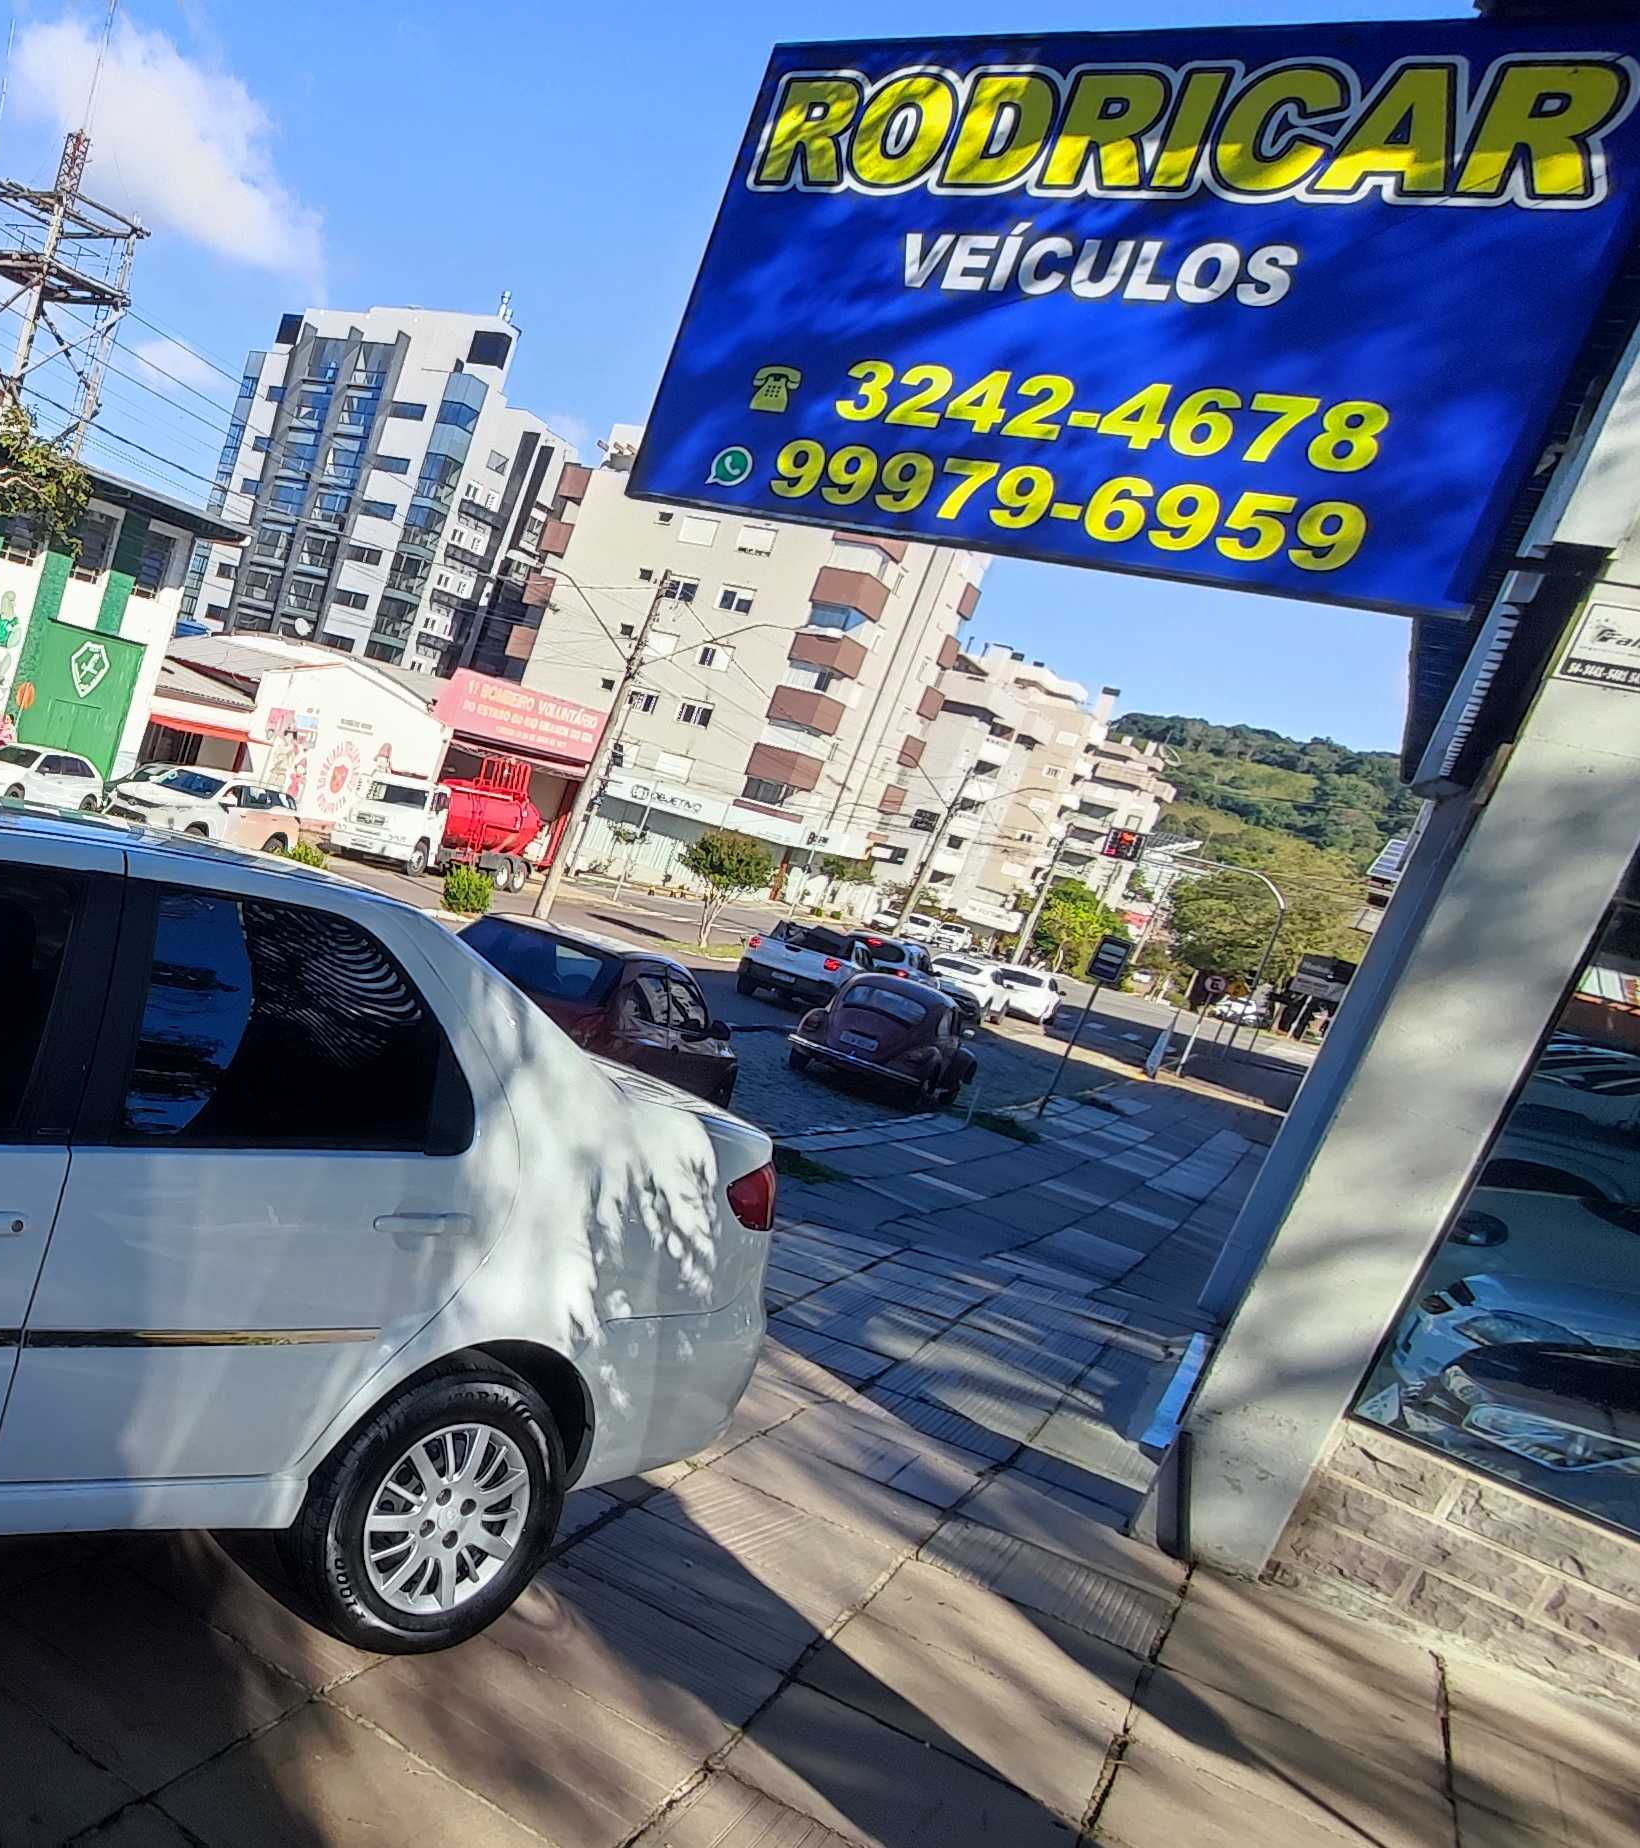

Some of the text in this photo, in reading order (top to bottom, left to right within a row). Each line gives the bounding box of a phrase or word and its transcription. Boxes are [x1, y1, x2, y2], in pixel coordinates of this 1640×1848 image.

[750, 55, 1630, 207] RODRICAR
[903, 223, 1299, 307] VEÍCULOS
[835, 359, 1391, 473] 3242-4678
[769, 437, 1368, 571] 99979-6959
[538, 700, 598, 729] VOLUNTÁRIO
